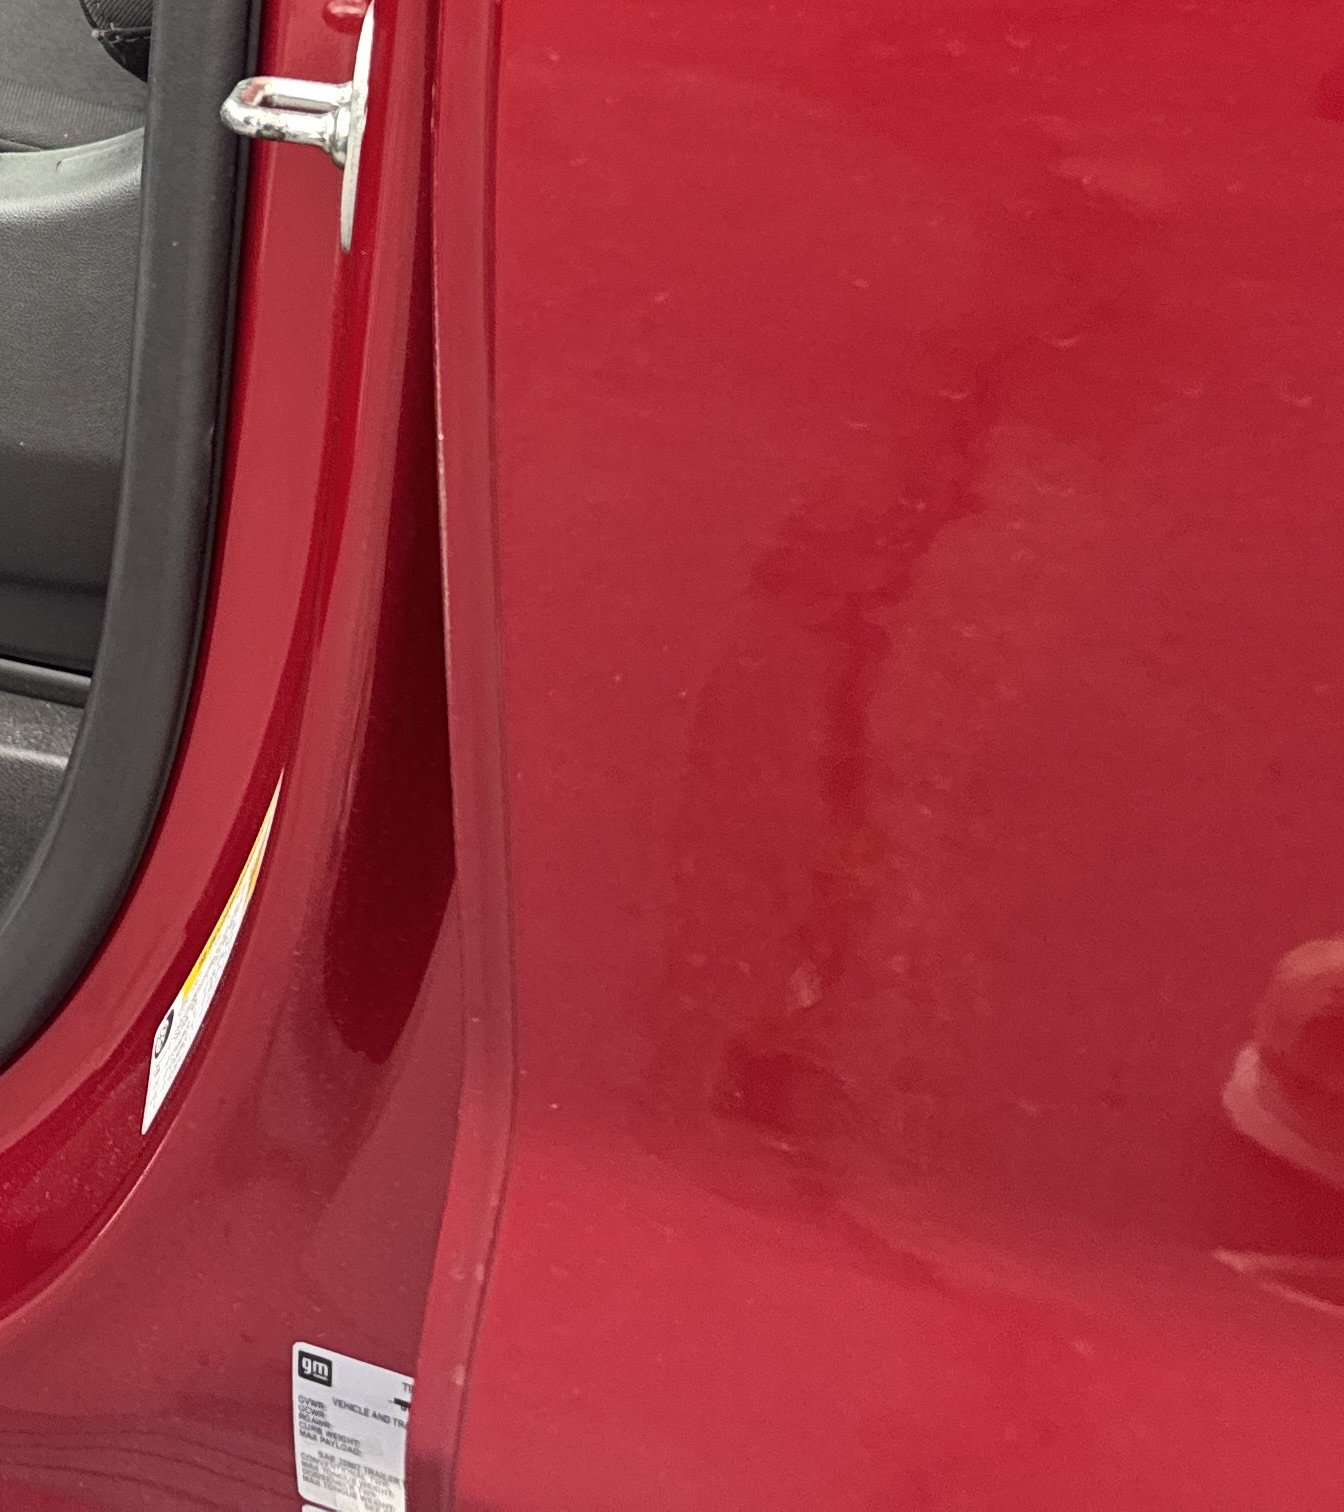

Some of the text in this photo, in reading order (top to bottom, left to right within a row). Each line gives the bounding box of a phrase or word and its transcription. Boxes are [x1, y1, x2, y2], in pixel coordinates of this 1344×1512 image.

[302, 1356, 329, 1380] gm
[332, 1396, 371, 1418] VEHICLE
[372, 1410, 391, 1425] AND
